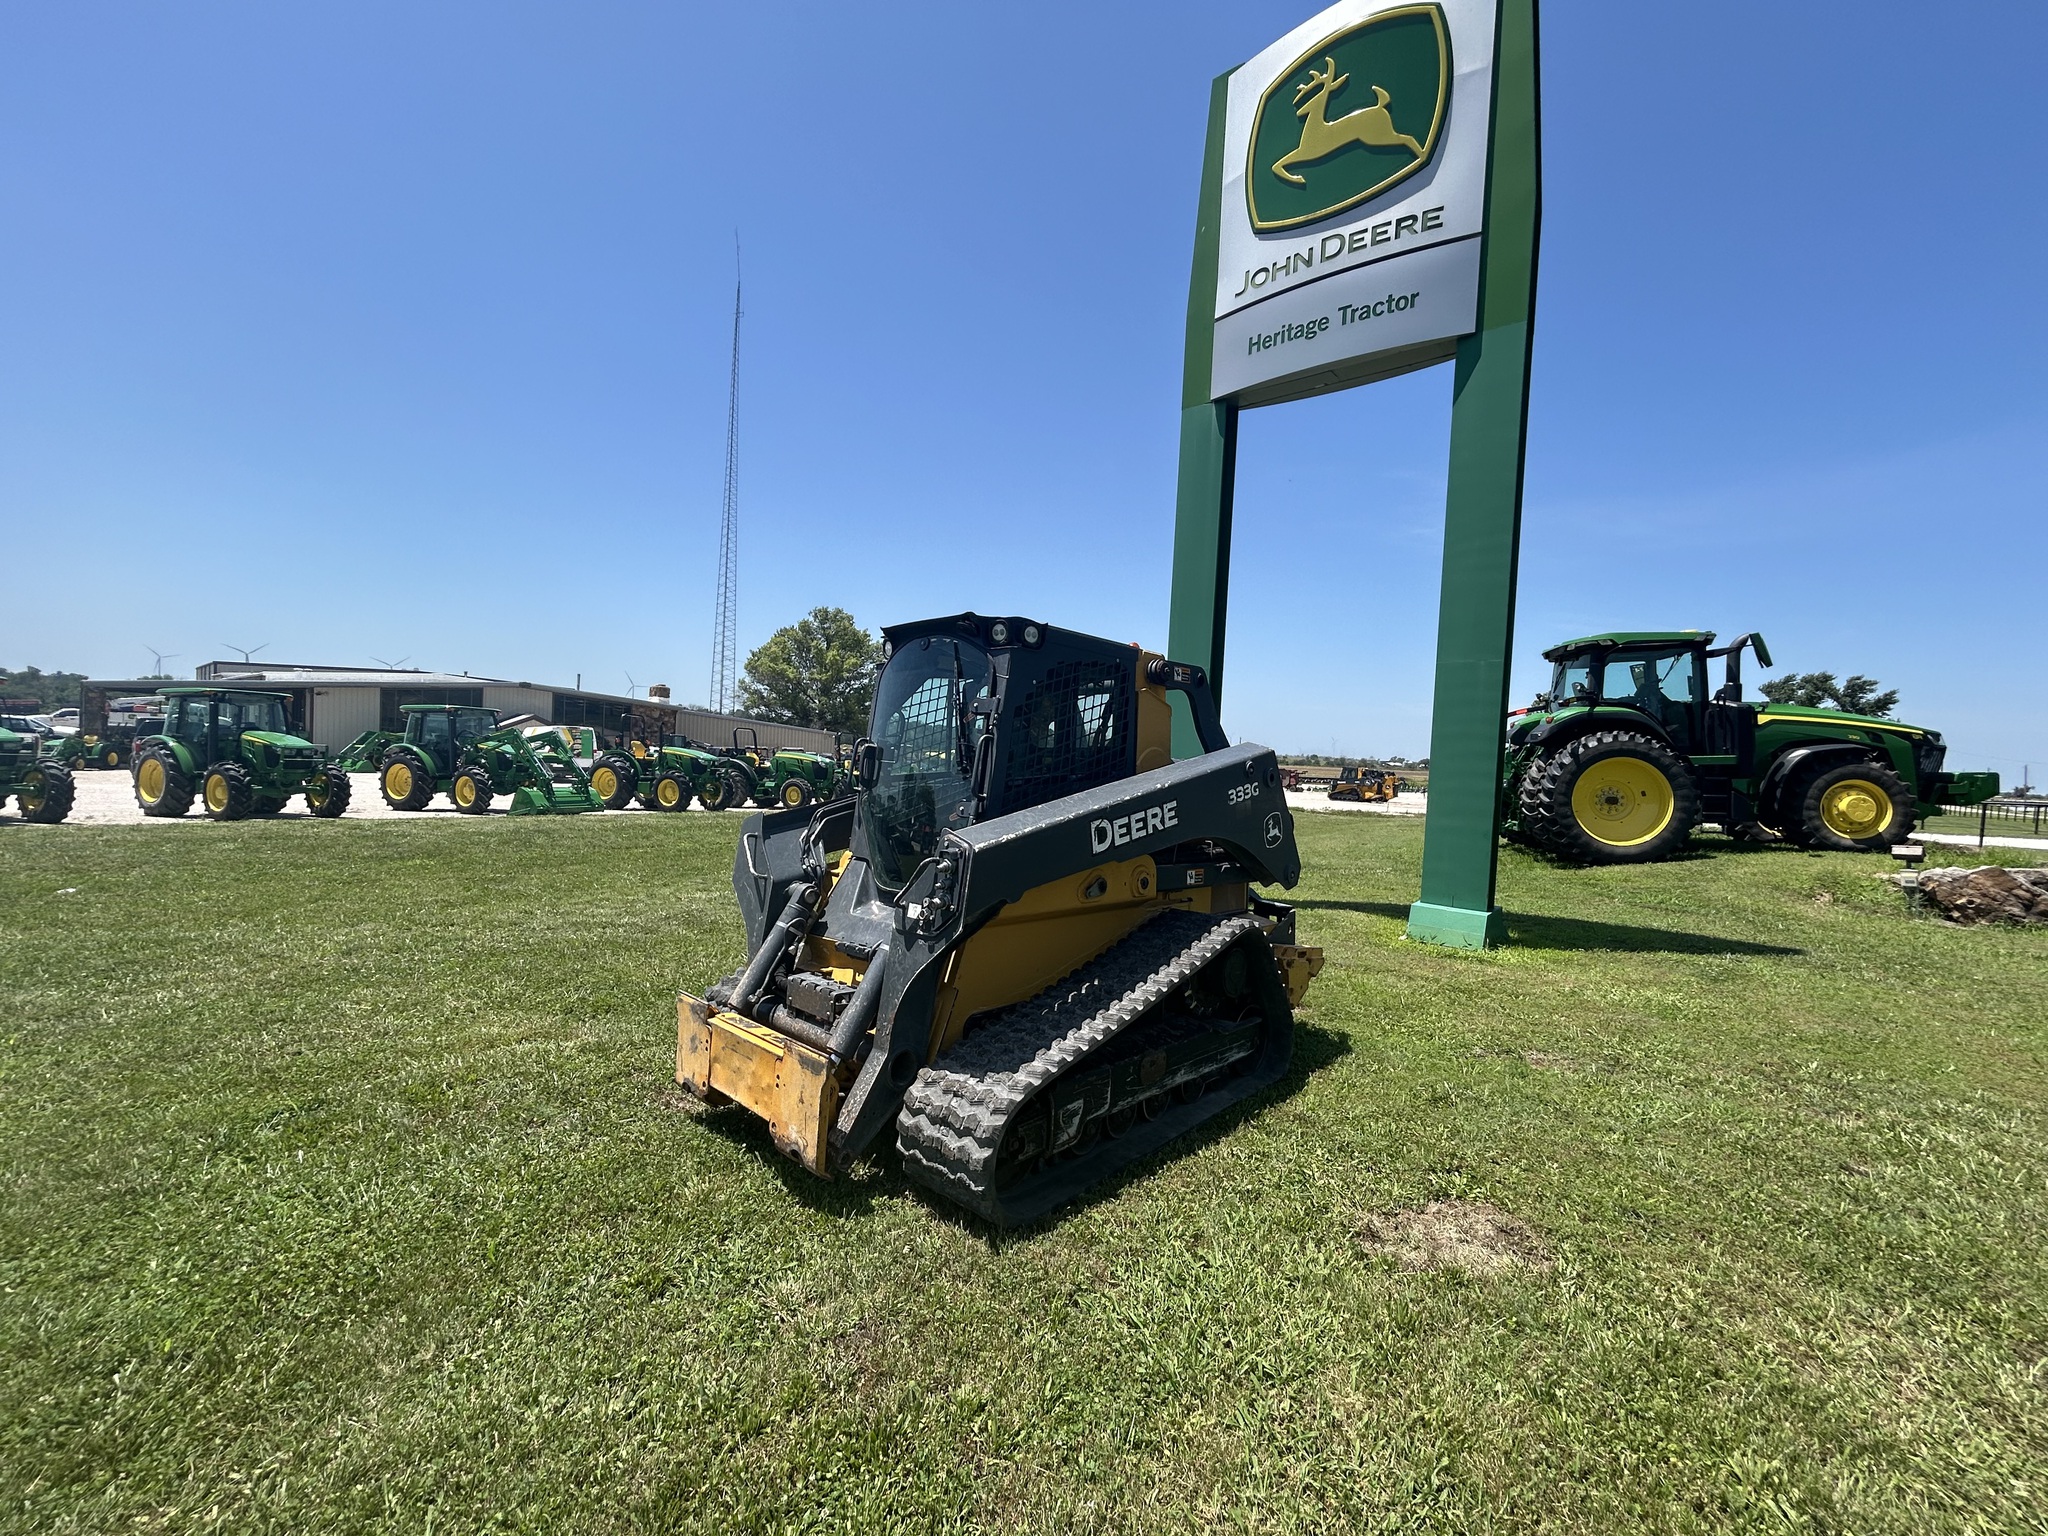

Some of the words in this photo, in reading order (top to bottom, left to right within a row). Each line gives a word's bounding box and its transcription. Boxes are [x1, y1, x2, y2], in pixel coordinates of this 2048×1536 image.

[1234, 246, 1314, 298] JOHN
[1320, 205, 1445, 264] DEERE
[1247, 316, 1330, 356] Heritage
[1337, 291, 1420, 326] Tractor
[1227, 781, 1260, 805] 333G
[1090, 800, 1179, 855] DEERE
